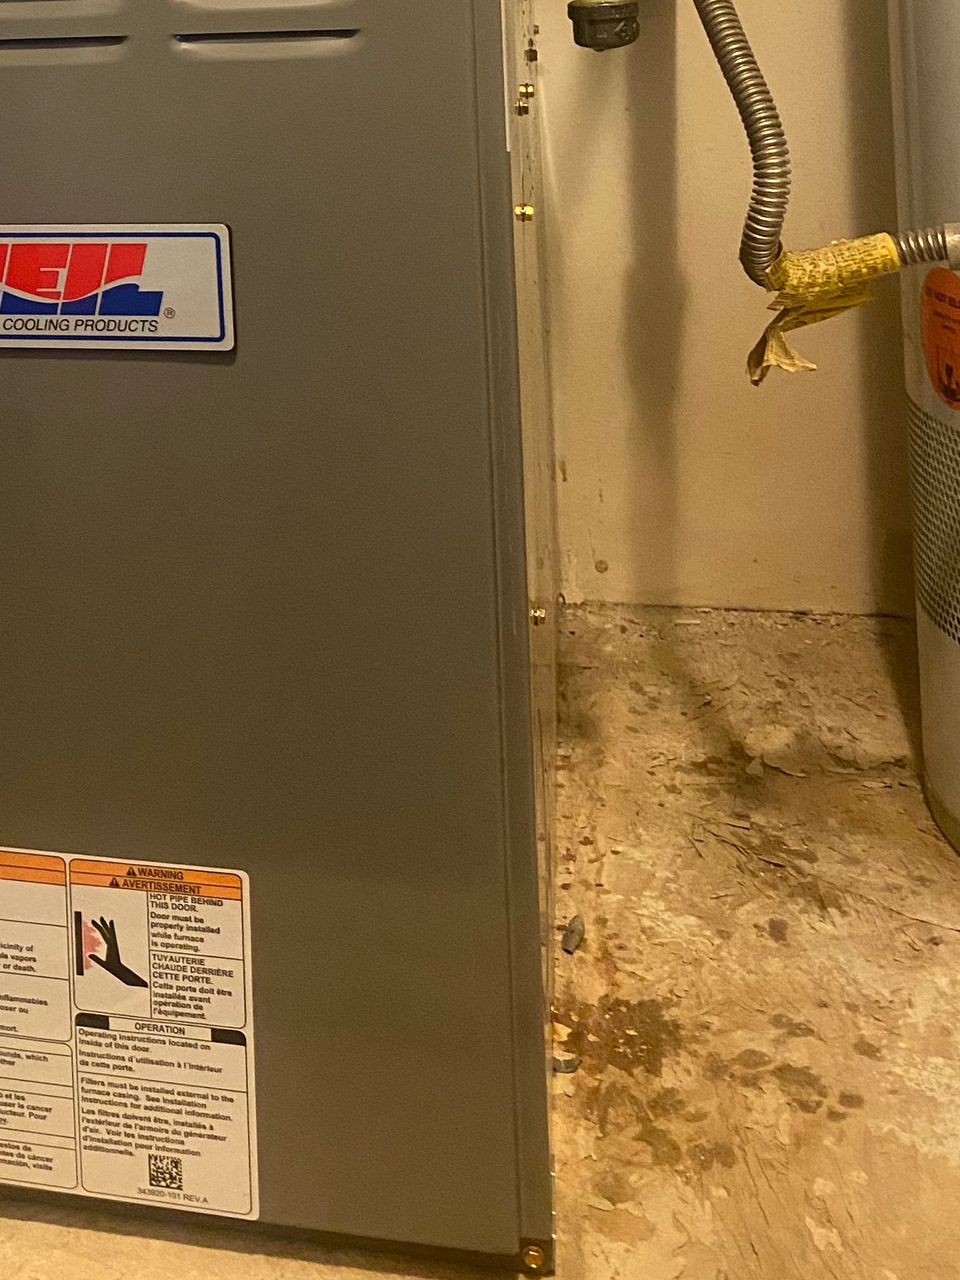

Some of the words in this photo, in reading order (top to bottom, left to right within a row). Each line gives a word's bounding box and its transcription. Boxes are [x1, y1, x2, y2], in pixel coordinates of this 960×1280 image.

[3, 318, 70, 332] COOLING
[74, 319, 158, 333] PRODUCTS
[137, 867, 184, 880] WARNING
[122, 878, 201, 894] AVERTISSEMENT
[150, 901, 170, 909] THIS
[170, 903, 198, 912] DOOR.
[190, 897, 223, 906] BEHIND
[150, 911, 170, 920] Door
[170, 913, 192, 922] must
[150, 920, 184, 932] properly
[184, 924, 220, 934] installed
[151, 930, 172, 939] while
[173, 933, 204, 942] furnace
[158, 940, 200, 952] operating.
[152, 953, 205, 965] TUYAUTERIE
[152, 962, 188, 972] CHAUDE
[189, 965, 233, 977] DERRIÈRE
[152, 971, 180, 980] CETTE
[181, 974, 213, 984] PORTE.
[152, 981, 174, 990] Cette
[174, 984, 197, 994] porte
[197, 986, 215, 994] doit
[215, 988, 232, 996] être
[187, 994, 210, 1003] avant
[134, 1022, 185, 1035] OPERATION
[24, 1053, 48, 1062] which
